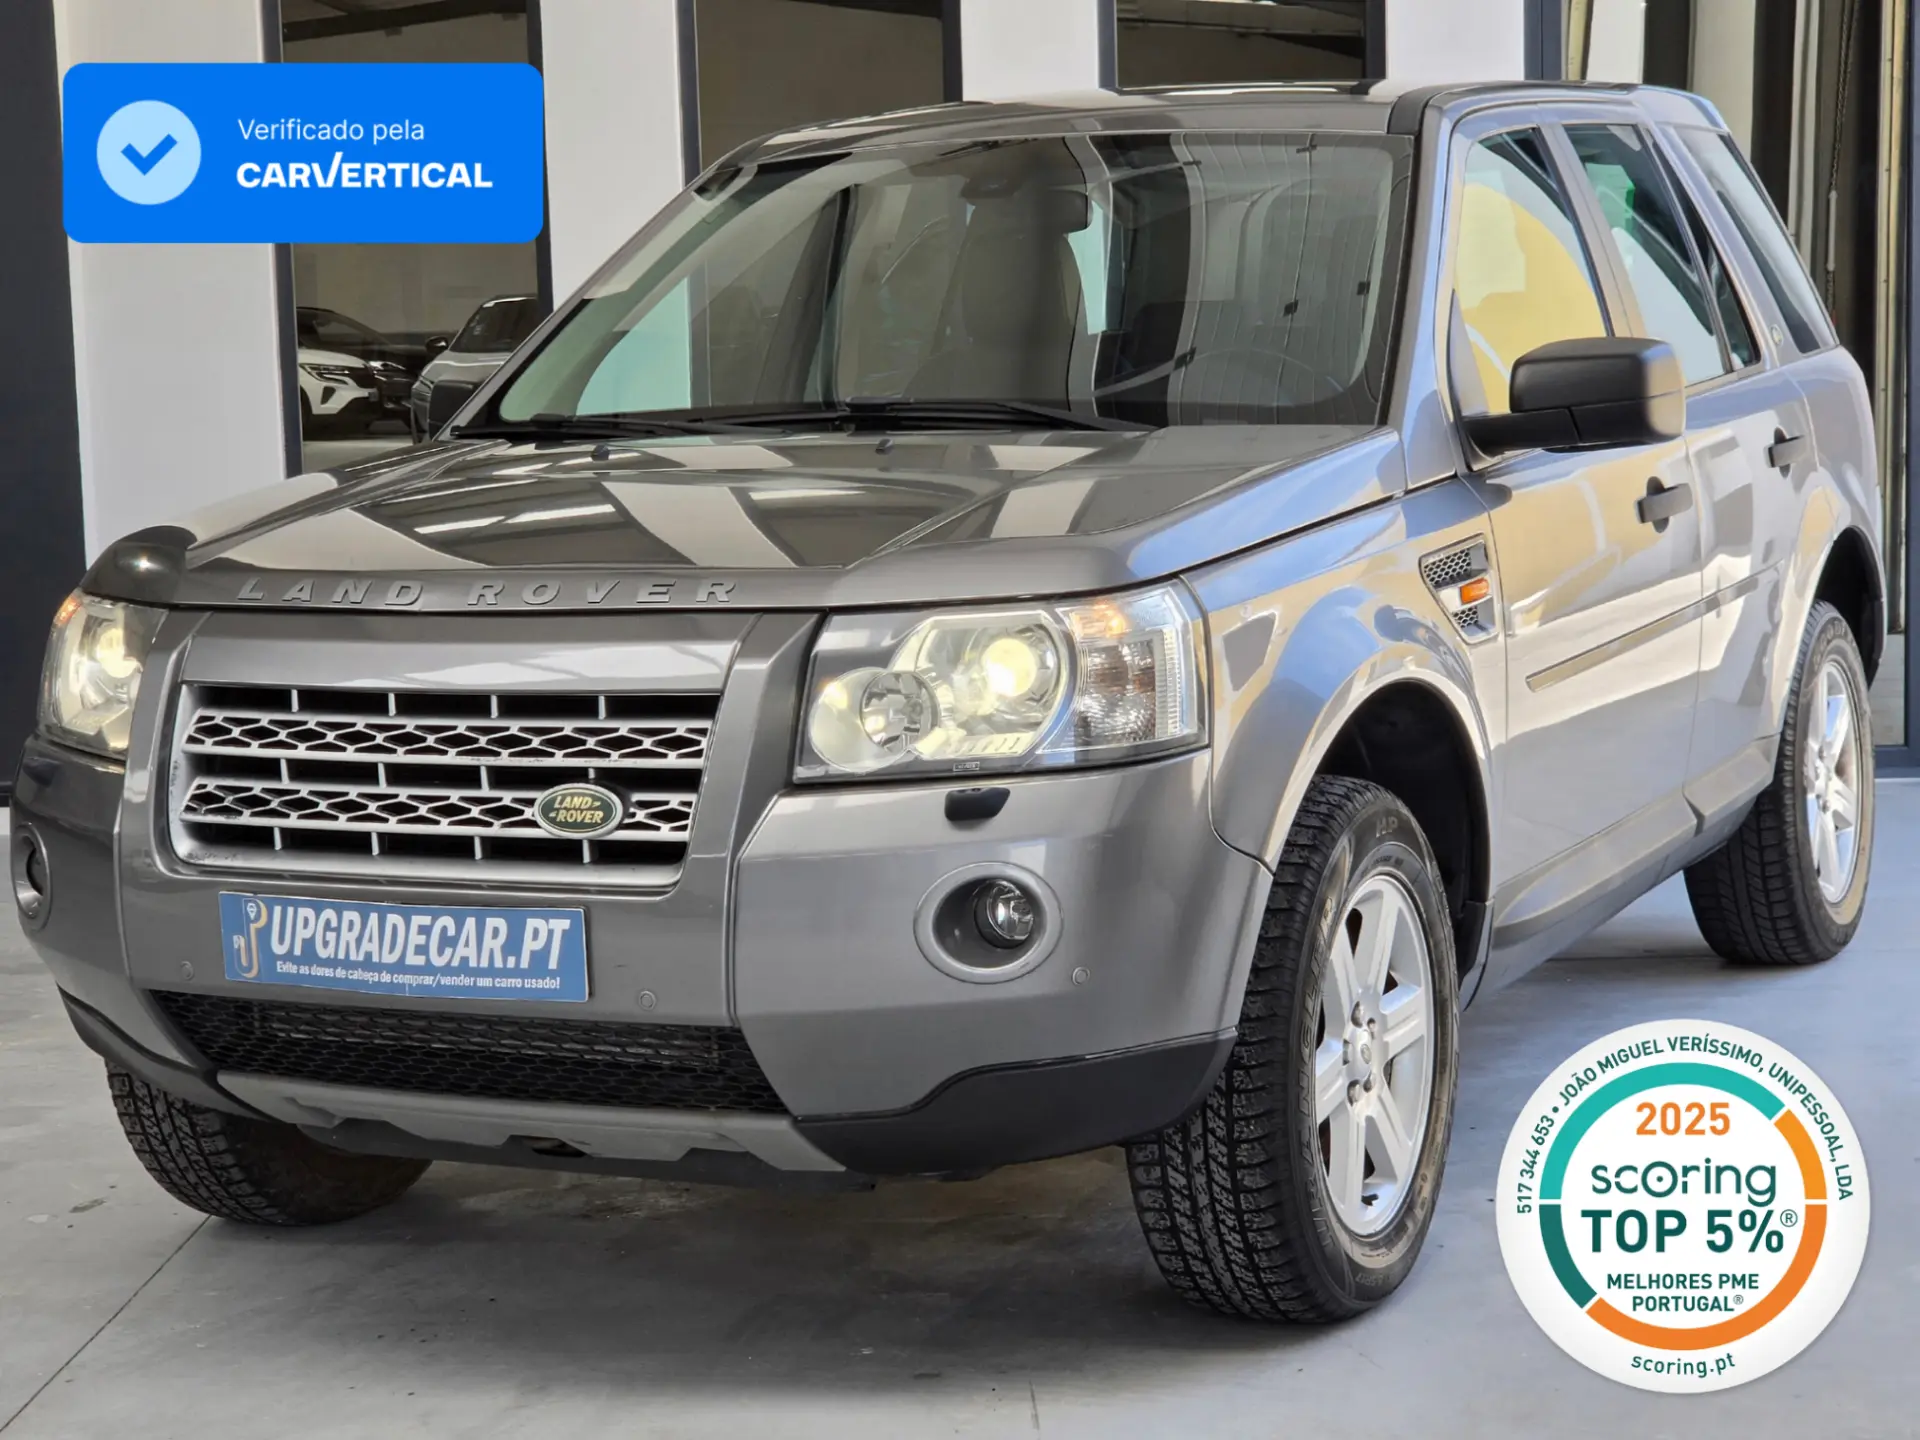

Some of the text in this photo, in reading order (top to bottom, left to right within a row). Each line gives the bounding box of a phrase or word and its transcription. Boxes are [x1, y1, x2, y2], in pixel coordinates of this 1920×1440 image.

[236, 578, 738, 606] LAND ROVER
[553, 795, 593, 809] LAND
[556, 809, 604, 824] ROVER
[270, 905, 571, 970] UPGRADECAR.PT
[276, 960, 298, 974] Evite
[299, 965, 310, 975] as
[311, 964, 335, 978] dores
[335, 967, 347, 979] de
[347, 967, 379, 984] cabeça
[380, 971, 392, 983] de
[476, 977, 493, 987] um
[494, 978, 522, 988] carro
[524, 977, 560, 989] usado!
